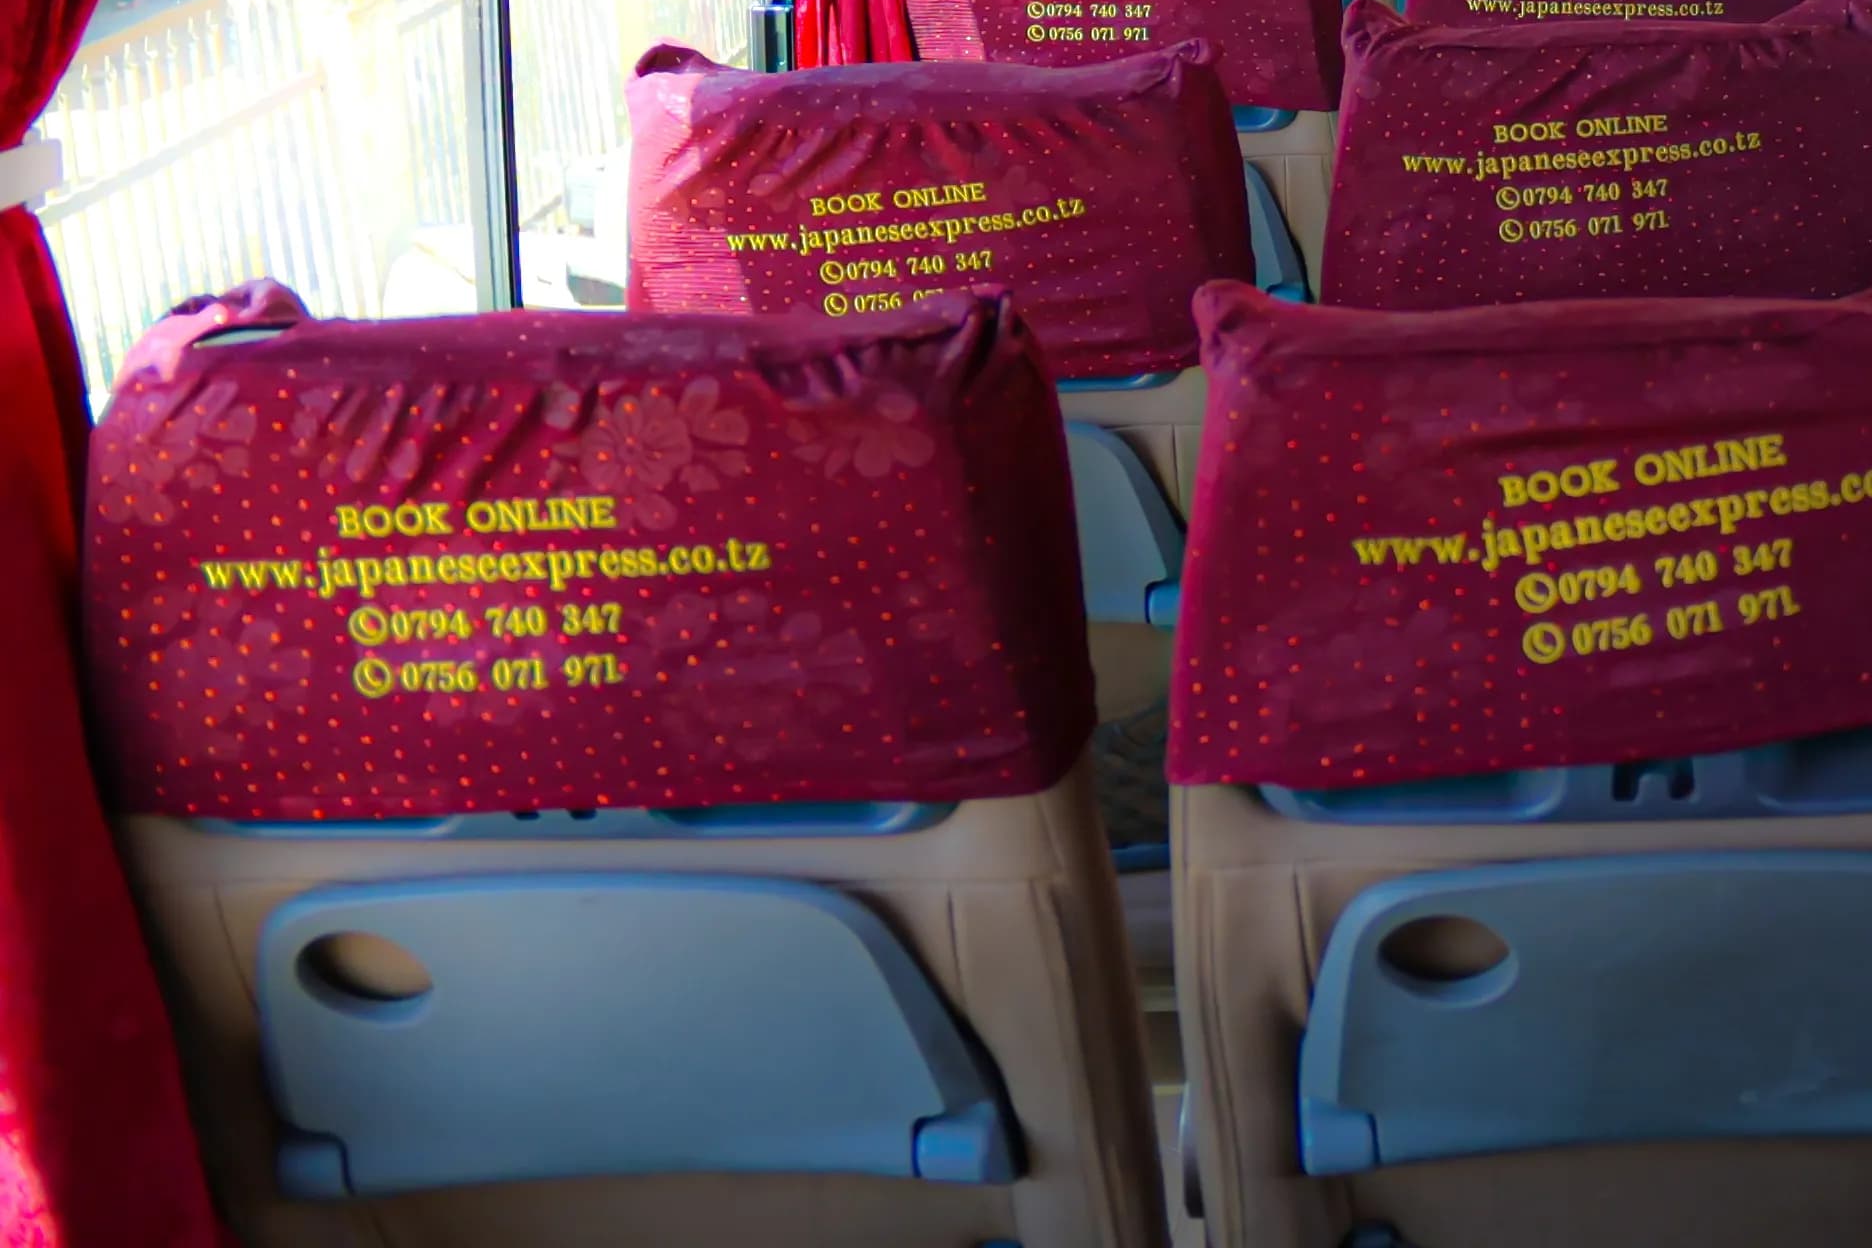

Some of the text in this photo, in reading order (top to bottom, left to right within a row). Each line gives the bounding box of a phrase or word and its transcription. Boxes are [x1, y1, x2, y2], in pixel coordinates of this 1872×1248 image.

[1047, 4, 1151, 18] 0794 740 347
[1049, 26, 1149, 41] 0756 071 971
[1493, 114, 1668, 144] BOOK ONLINE
[1401, 129, 1762, 182] www.japaneseexpress.co.tz
[810, 182, 987, 216] BOOK ONLINE
[1522, 178, 1669, 207] 0794 740 347
[726, 196, 1086, 256] www.japaneseexpress.co.tz
[1529, 210, 1670, 241] 0756 071 971
[846, 250, 993, 281] 0794 740 347
[854, 291, 901, 313] 0756
[1497, 432, 1788, 508] BOOK ONLINE
[335, 495, 618, 540] BOOK ONLINE
[200, 537, 772, 600] www.japaneseexpress.co.tz
[1557, 537, 1795, 606] 0794 740 347
[390, 602, 624, 641] 0794 740 347
[1571, 584, 1802, 657] 0756 071 971
[400, 653, 625, 694] 0756 071 971
